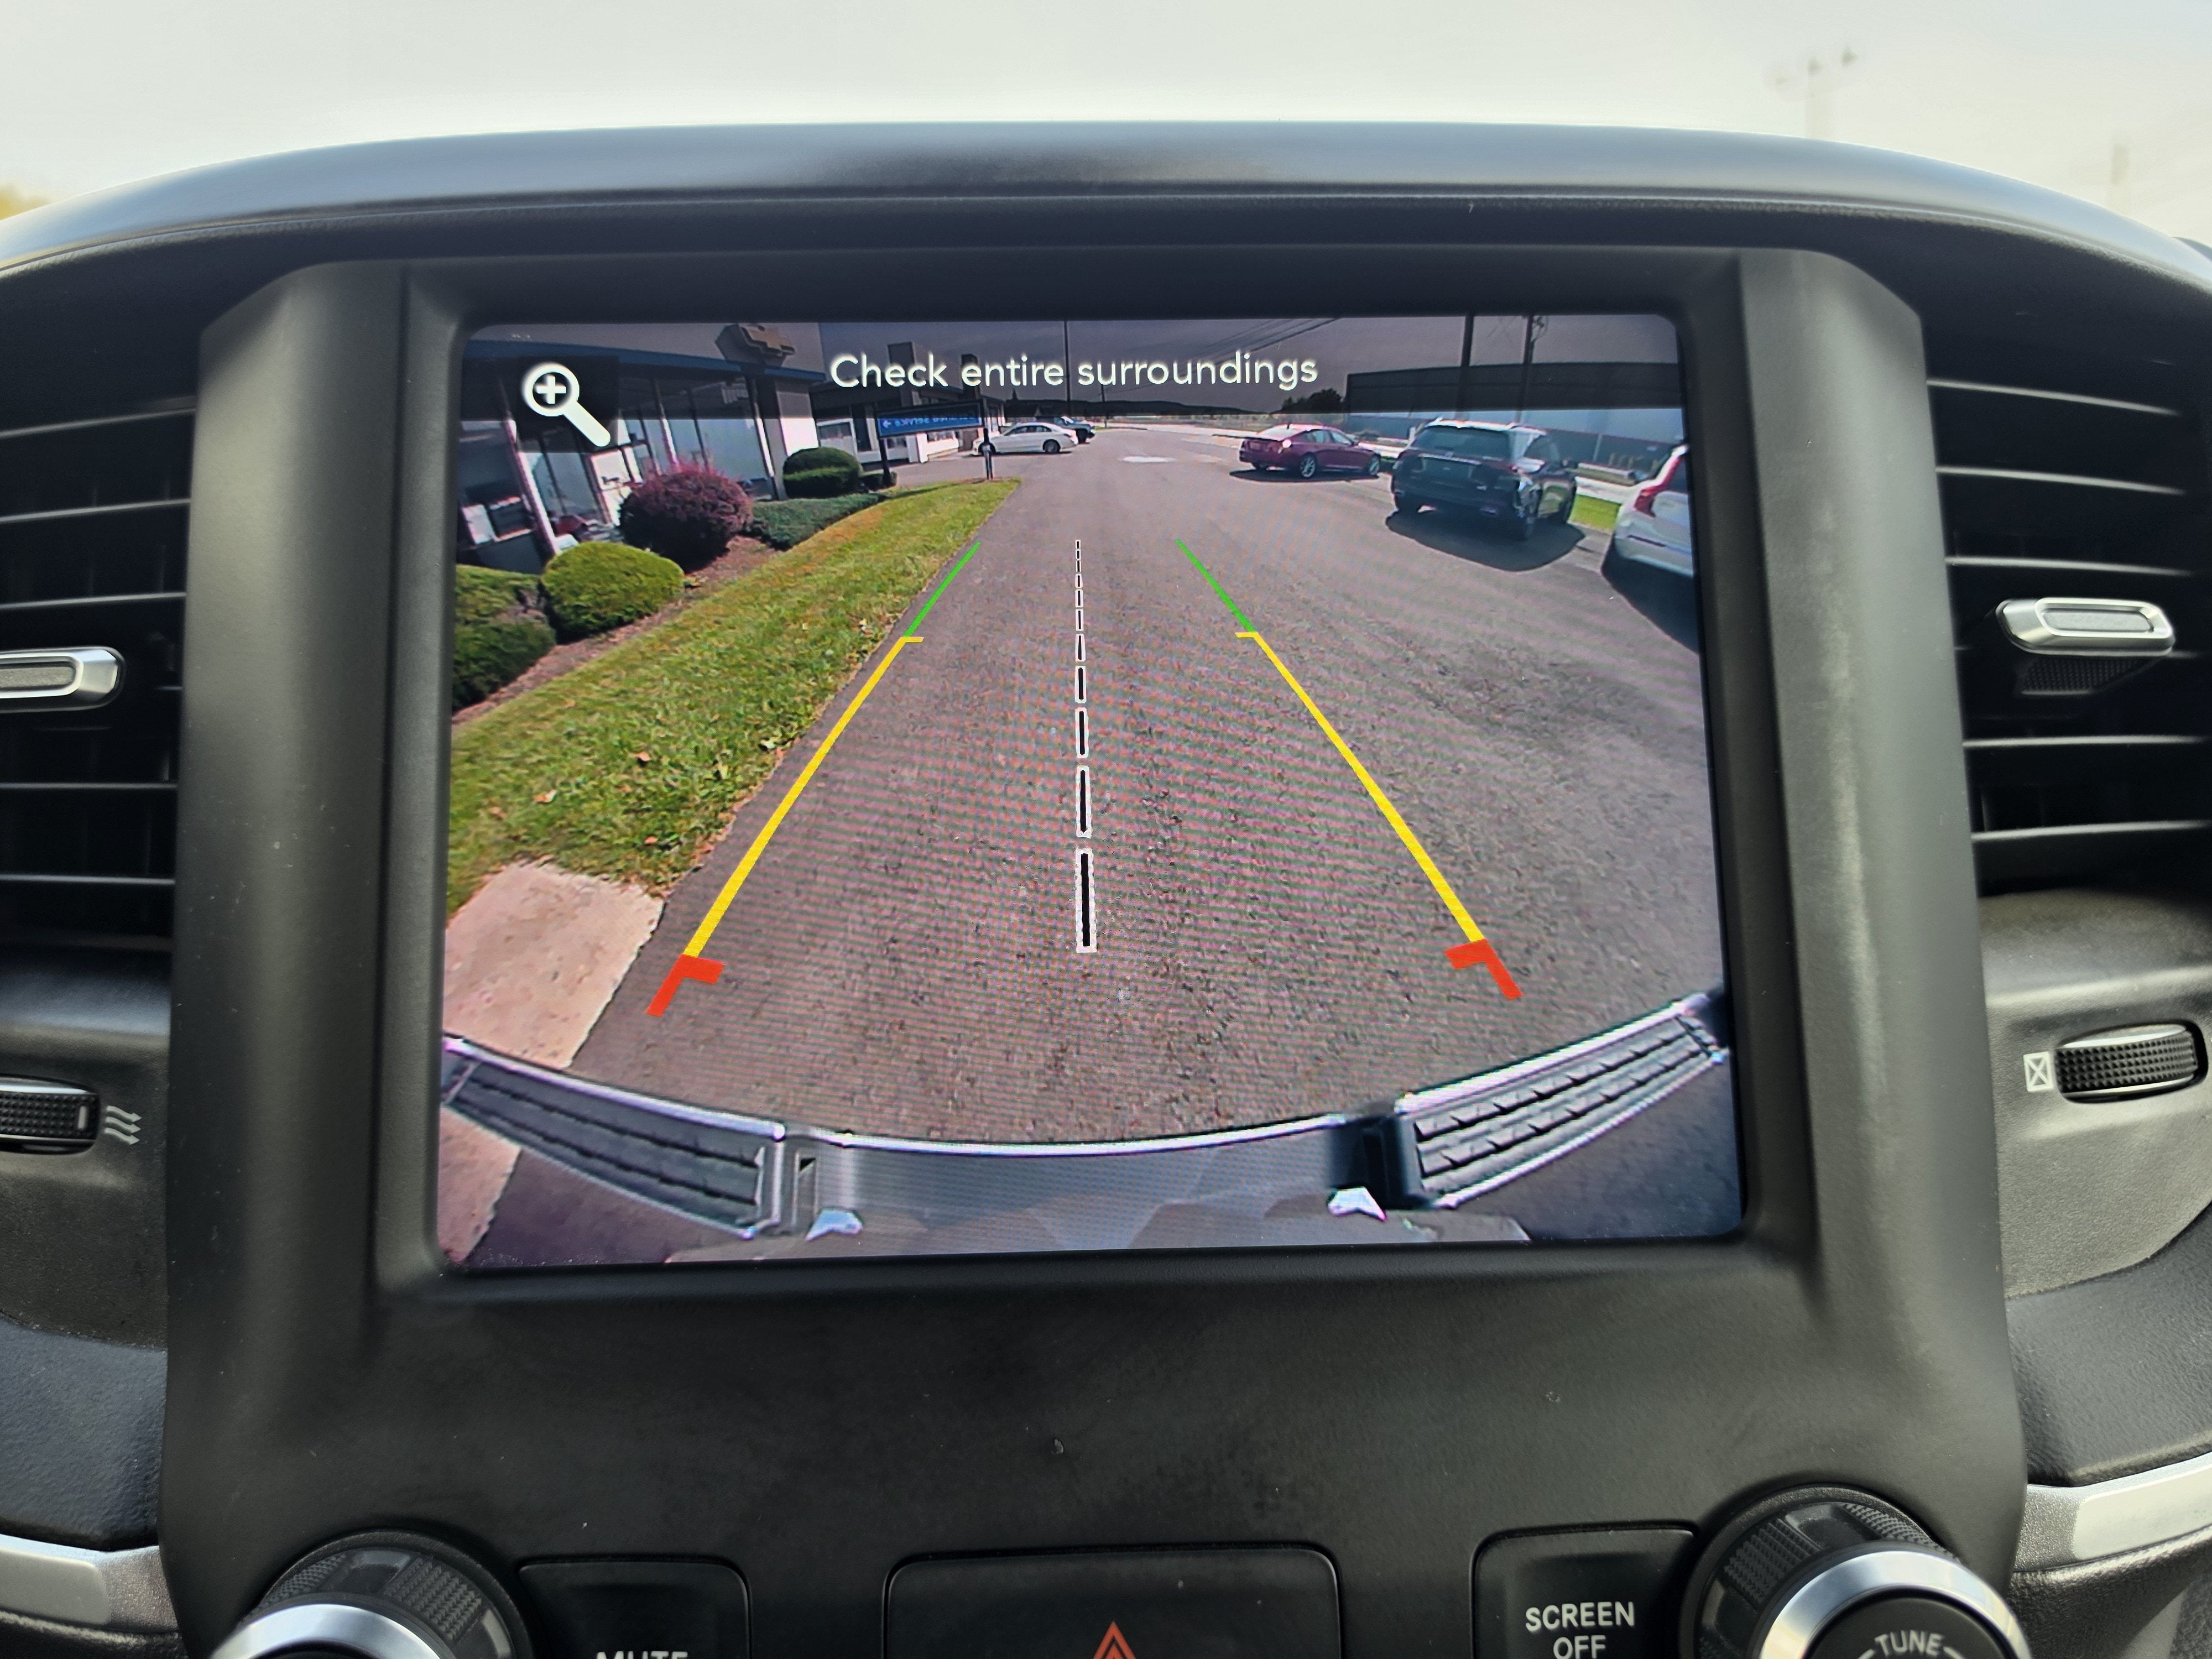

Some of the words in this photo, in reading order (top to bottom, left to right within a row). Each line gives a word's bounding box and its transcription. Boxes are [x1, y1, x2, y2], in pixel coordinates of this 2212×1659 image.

[831, 352, 948, 387] Check
[961, 352, 1065, 387] entire
[1077, 349, 1318, 391] surroundings
[1525, 1601, 1635, 1632] SCREEN
[1552, 1634, 1606, 1659] OFF
[1874, 1629, 1945, 1656] TUNE
